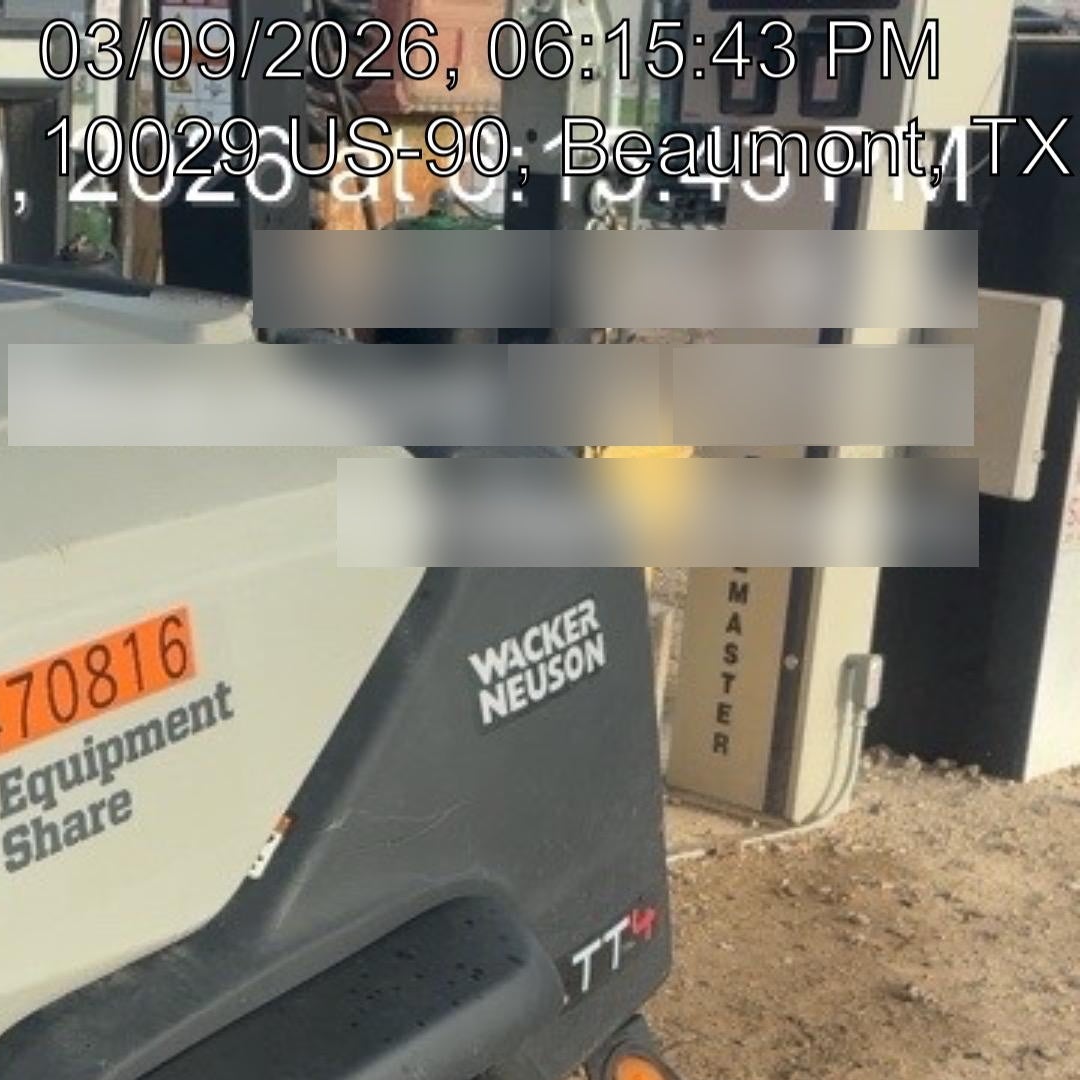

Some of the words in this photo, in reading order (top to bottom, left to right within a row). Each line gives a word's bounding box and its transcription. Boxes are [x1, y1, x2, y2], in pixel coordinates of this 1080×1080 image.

[467, 598, 601, 686] WACKER
[478, 632, 607, 725] NEUSON
[713, 567, 748, 757] MASTER
[1, 789, 133, 873] Share
[563, 907, 657, 1004] TT4
